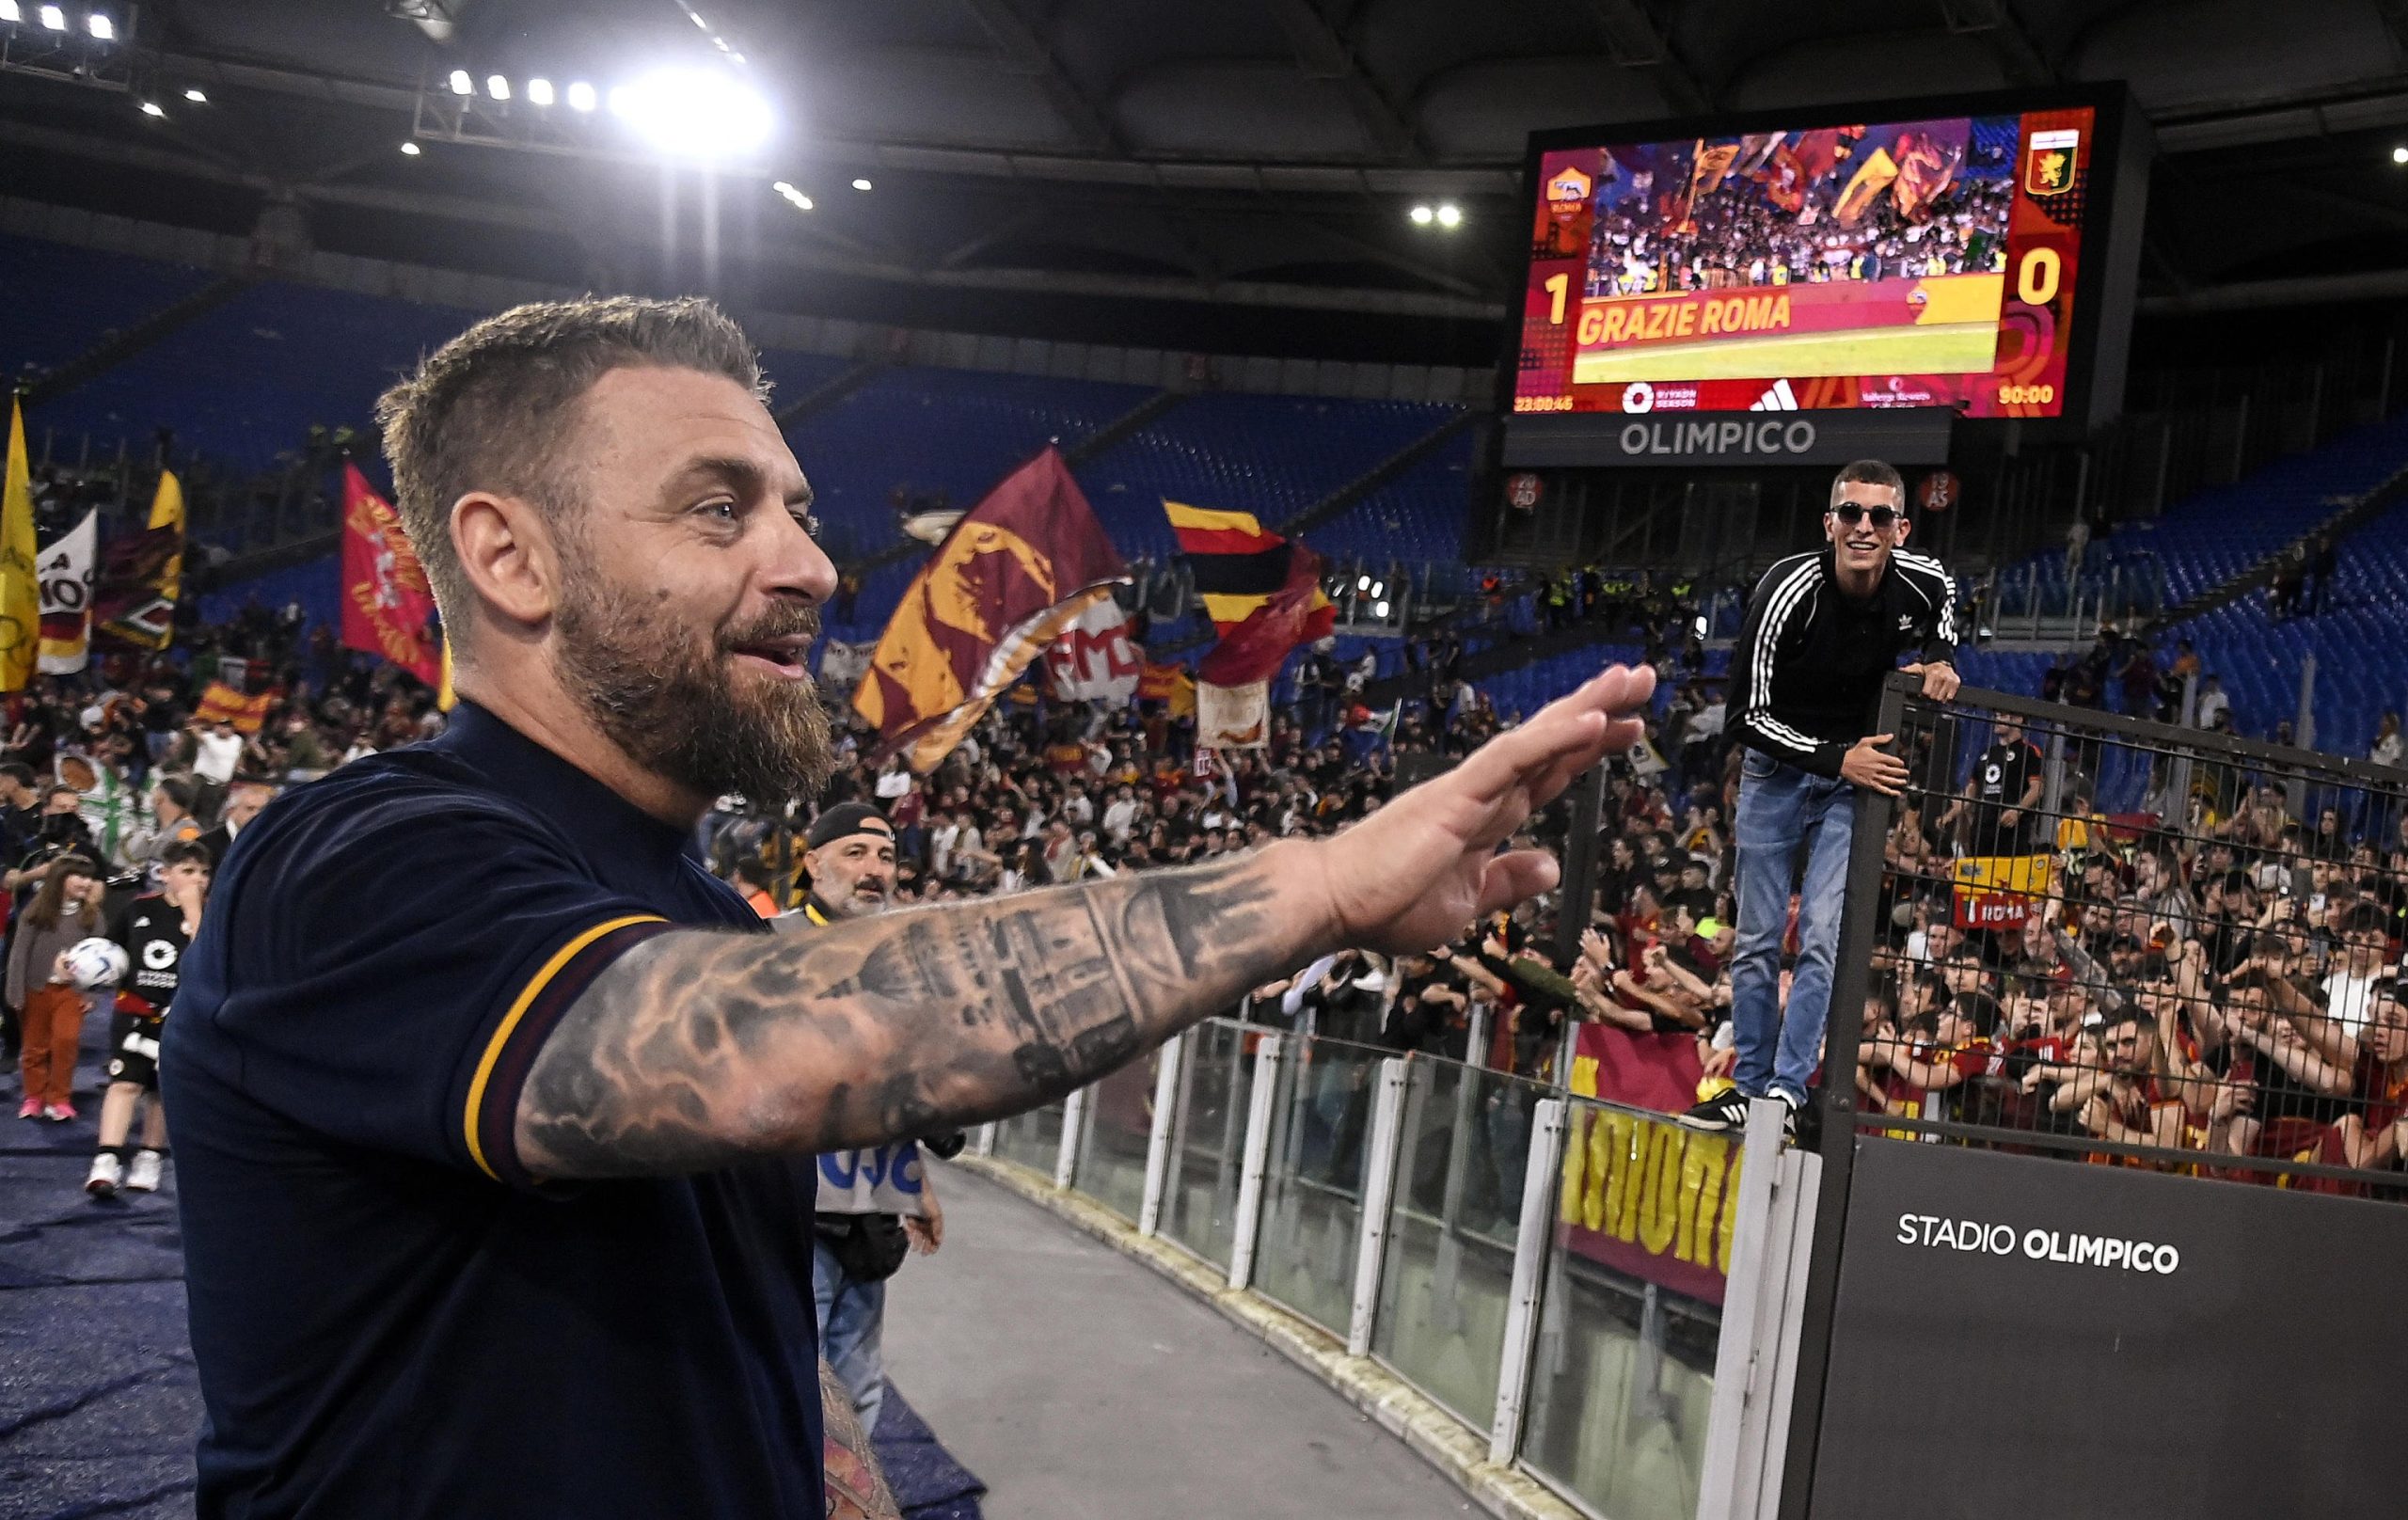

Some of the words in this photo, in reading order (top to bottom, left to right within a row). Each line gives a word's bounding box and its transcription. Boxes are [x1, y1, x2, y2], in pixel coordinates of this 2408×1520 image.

[1545, 273, 1568, 325] 1
[2018, 247, 2061, 306] 0
[1577, 302, 1699, 346] GRAZIE
[1700, 293, 1791, 335] ROMA
[1998, 384, 2054, 404] 90:00
[1620, 420, 1816, 456] OLIMPICO
[1896, 1212, 2017, 1256] STADIO
[2021, 1227, 2180, 1275] OLIMPICO
